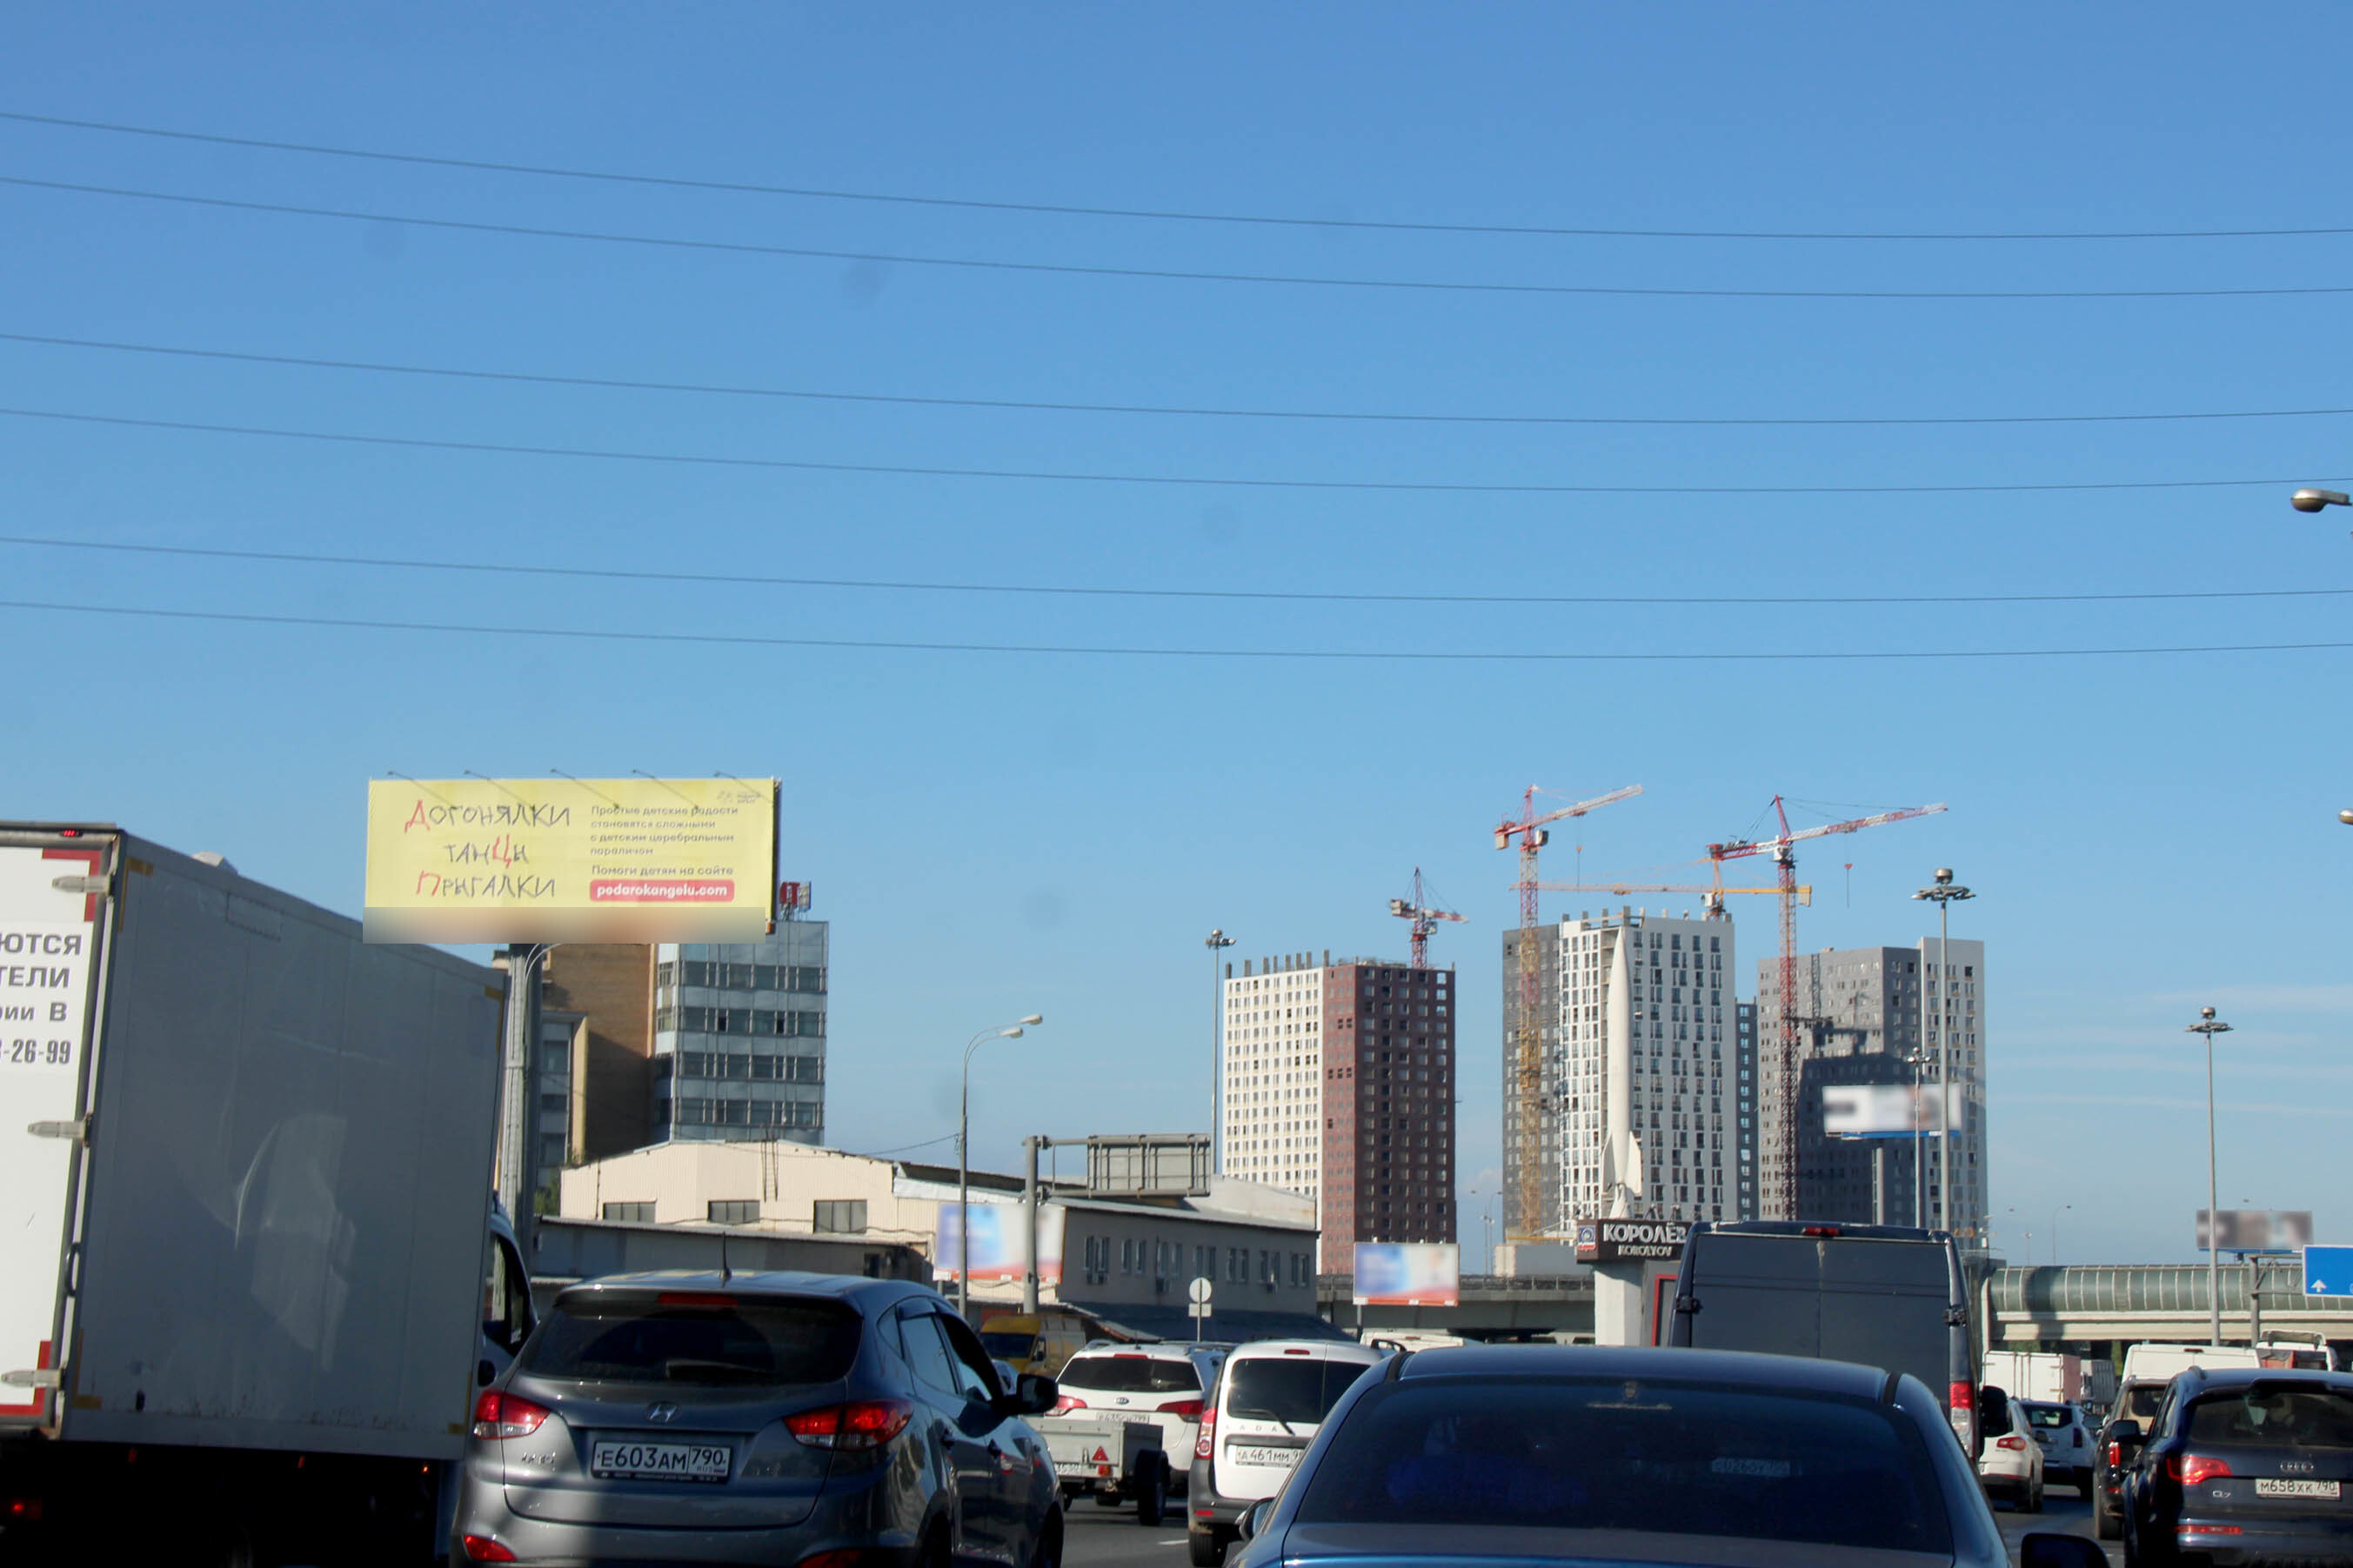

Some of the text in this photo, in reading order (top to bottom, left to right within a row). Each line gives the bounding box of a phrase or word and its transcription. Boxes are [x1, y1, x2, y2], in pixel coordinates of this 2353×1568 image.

[404, 799, 570, 834] ДОГОНЯЛКИ
[592, 806, 739, 817] Простые детские радости
[649, 832, 734, 843] церебральным
[591, 848, 653, 857] параличом
[592, 865, 637, 875] Помоги
[640, 867, 676, 876] детям
[697, 865, 733, 875] сайте
[597, 883, 728, 898] podarokangelu.com
[0, 1038, 71, 1064] -26-99
[1603, 1222, 1687, 1244] КОРОЛЁВ
[1618, 1245, 1672, 1257] KOROLYOV
[692, 1447, 724, 1465] 790
